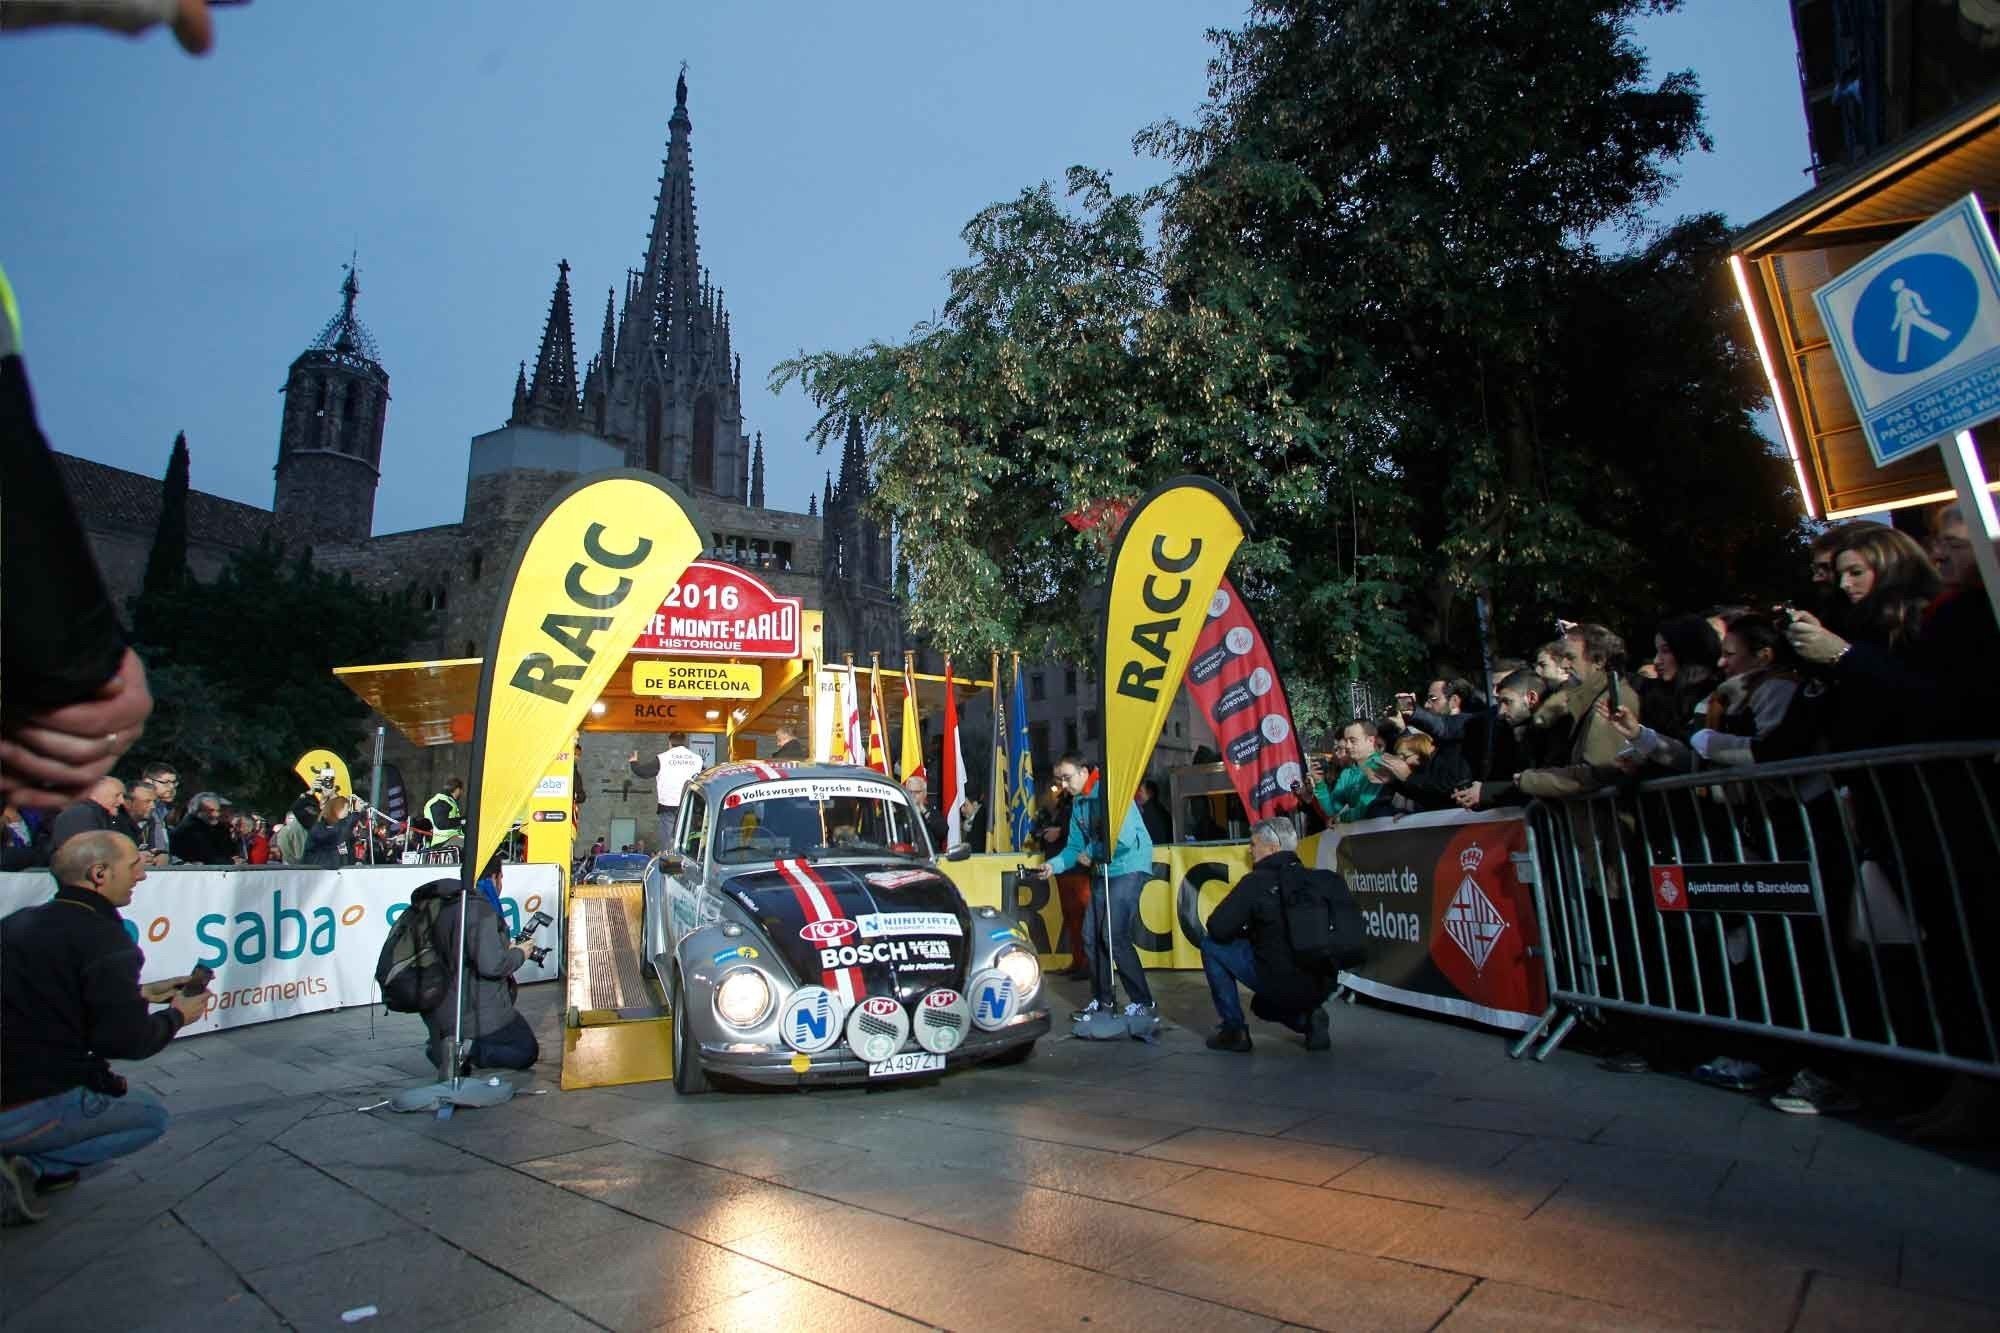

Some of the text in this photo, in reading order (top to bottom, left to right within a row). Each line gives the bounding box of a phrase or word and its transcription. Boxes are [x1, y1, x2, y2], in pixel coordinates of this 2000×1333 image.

[1886, 407, 1914, 426] PAS
[1881, 418, 1917, 440] PASO
[663, 583, 739, 611] 2016
[509, 521, 653, 705] RACC
[671, 605, 793, 641] MONTE-CARLO
[1116, 534, 1202, 703] RACC
[659, 638, 742, 651] HISTORIQUE
[669, 667, 728, 679] SORTIDA
[645, 678, 750, 692] DE BARCELONA
[634, 703, 678, 718] RACC
[538, 777, 562, 790] aba
[742, 786, 807, 801] Volkswagen
[857, 785, 891, 796] Austria
[1400, 865, 1418, 893] de
[1688, 881, 1810, 895] Ajuntament de Barcelona
[196, 890, 337, 970] saba
[820, 942, 908, 969] BOSCH
[204, 975, 328, 1021] parcaments
